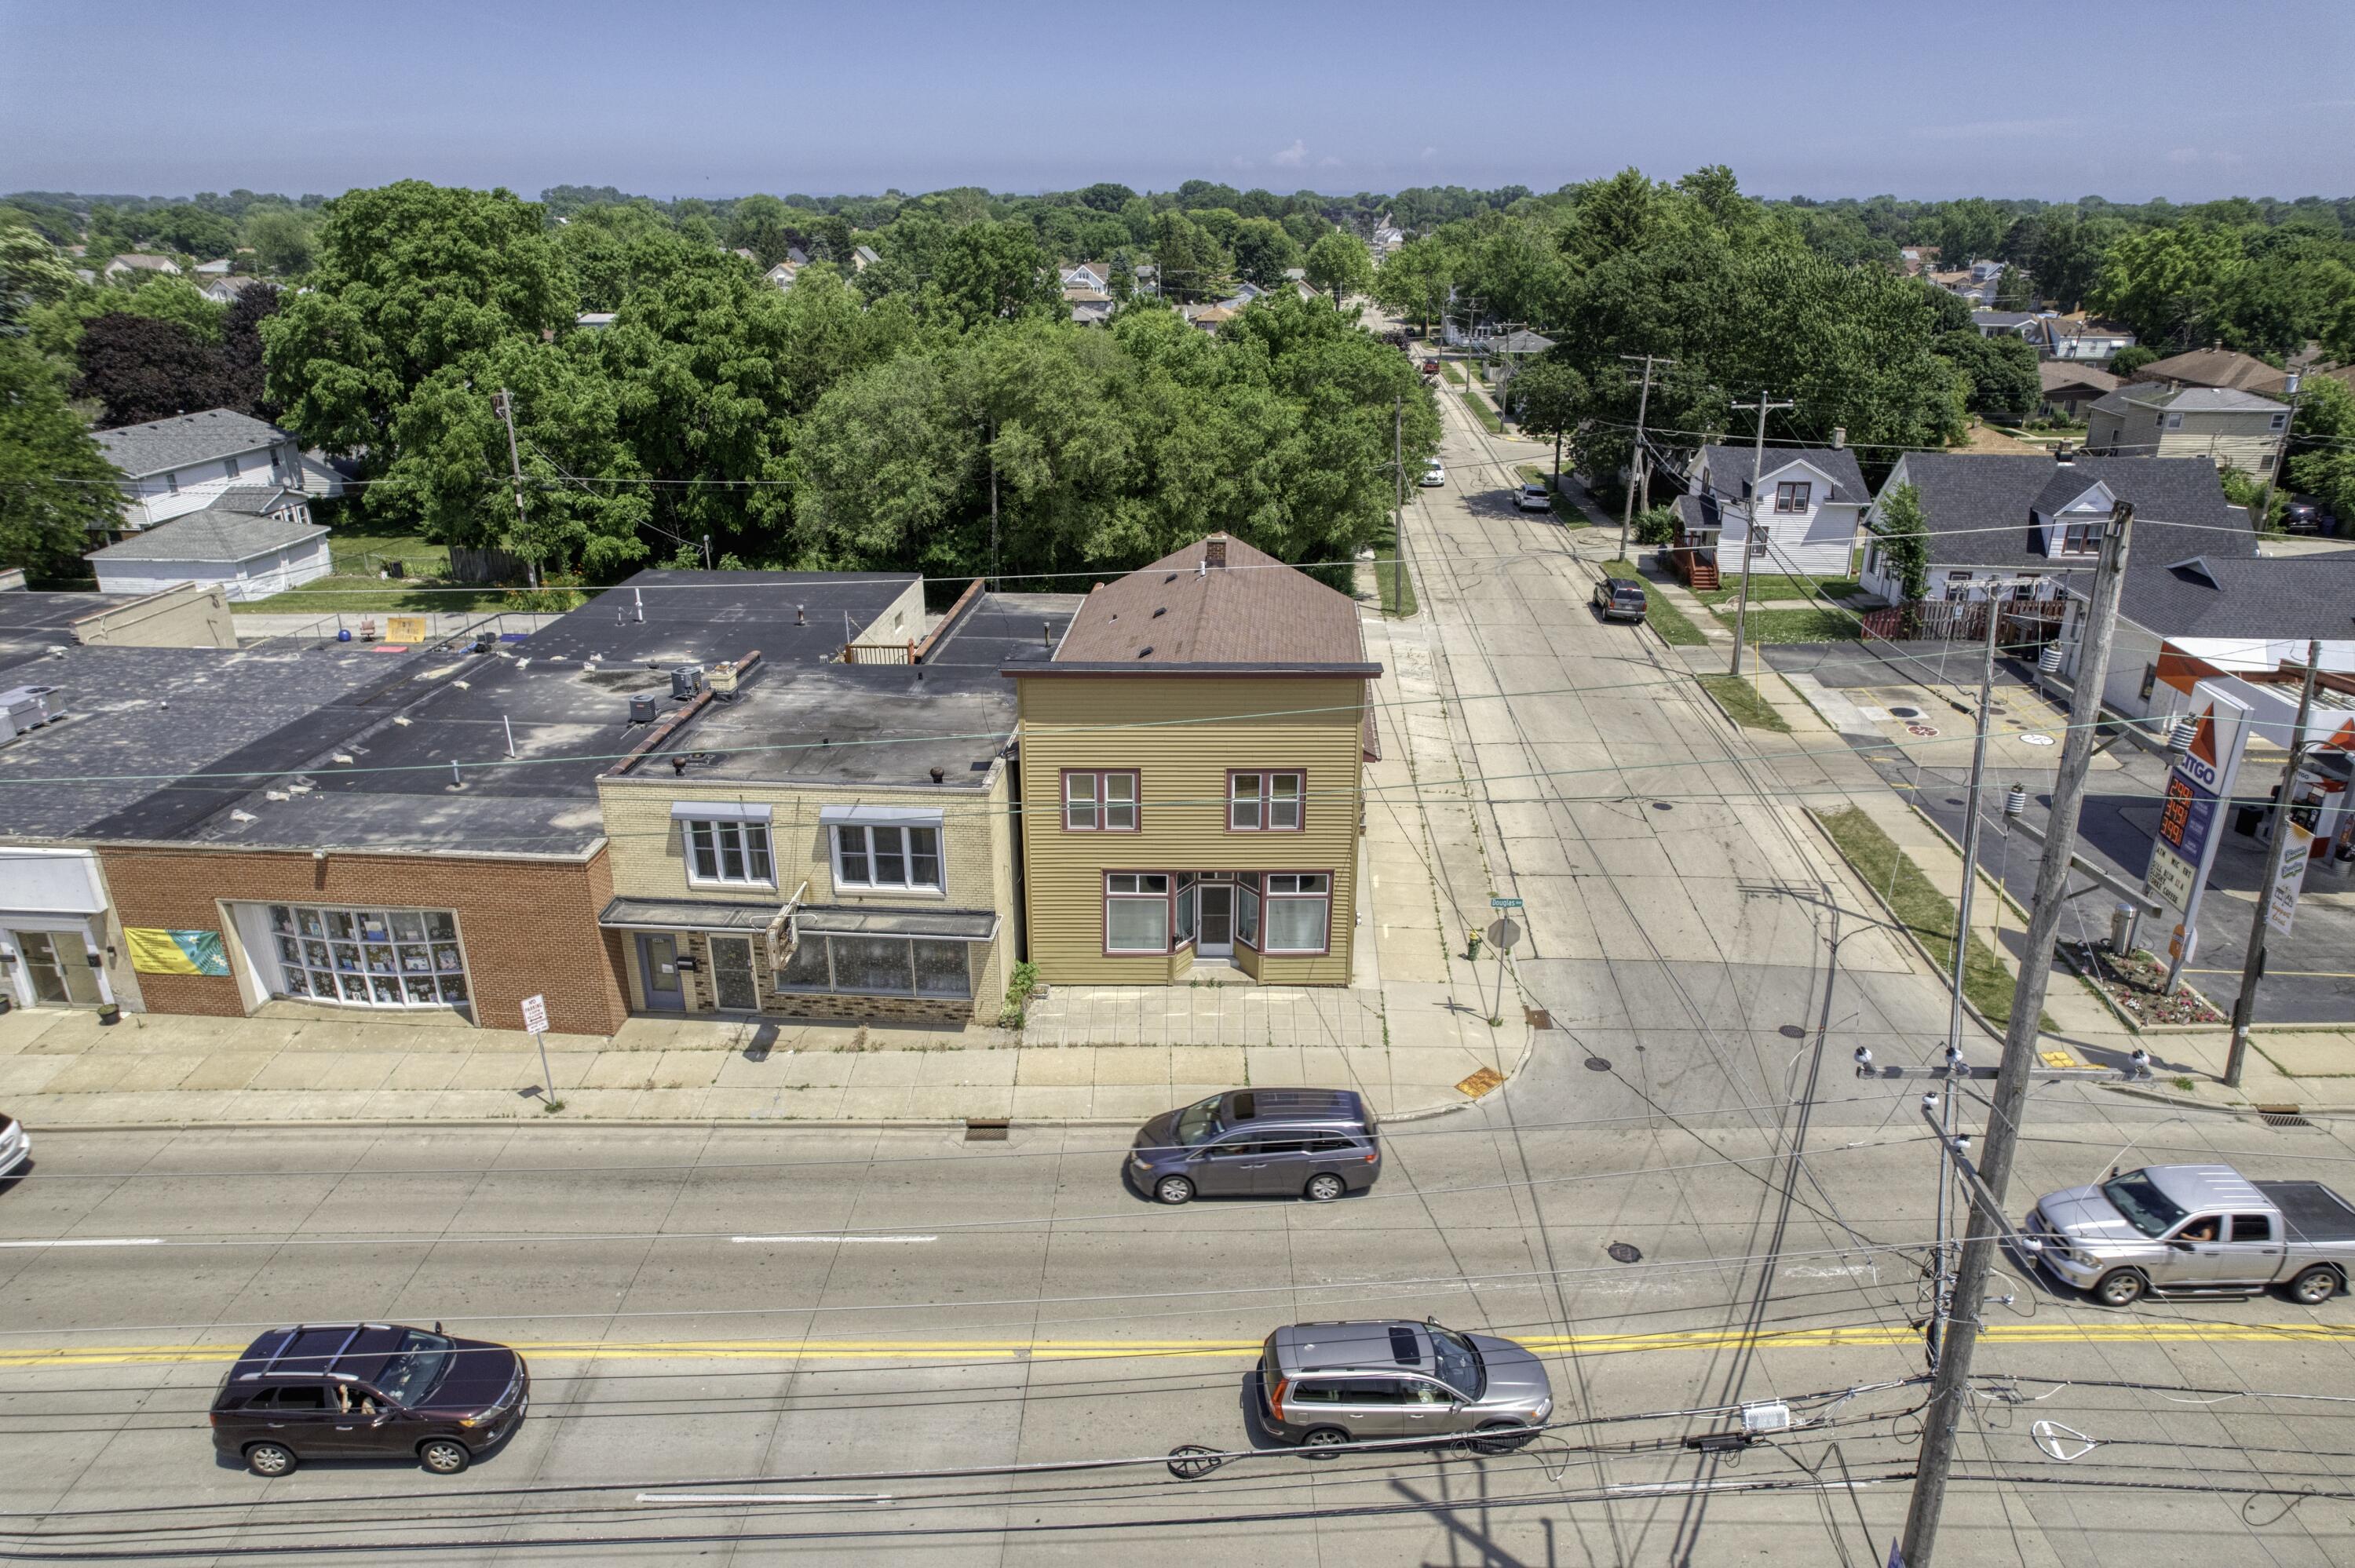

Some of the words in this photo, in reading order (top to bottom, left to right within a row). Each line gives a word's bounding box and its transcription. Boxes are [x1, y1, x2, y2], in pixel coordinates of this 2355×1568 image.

[2156, 847, 2166, 858] ATM
[2163, 887, 2178, 903] COFFEE
[1492, 899, 1515, 907] Douglas
